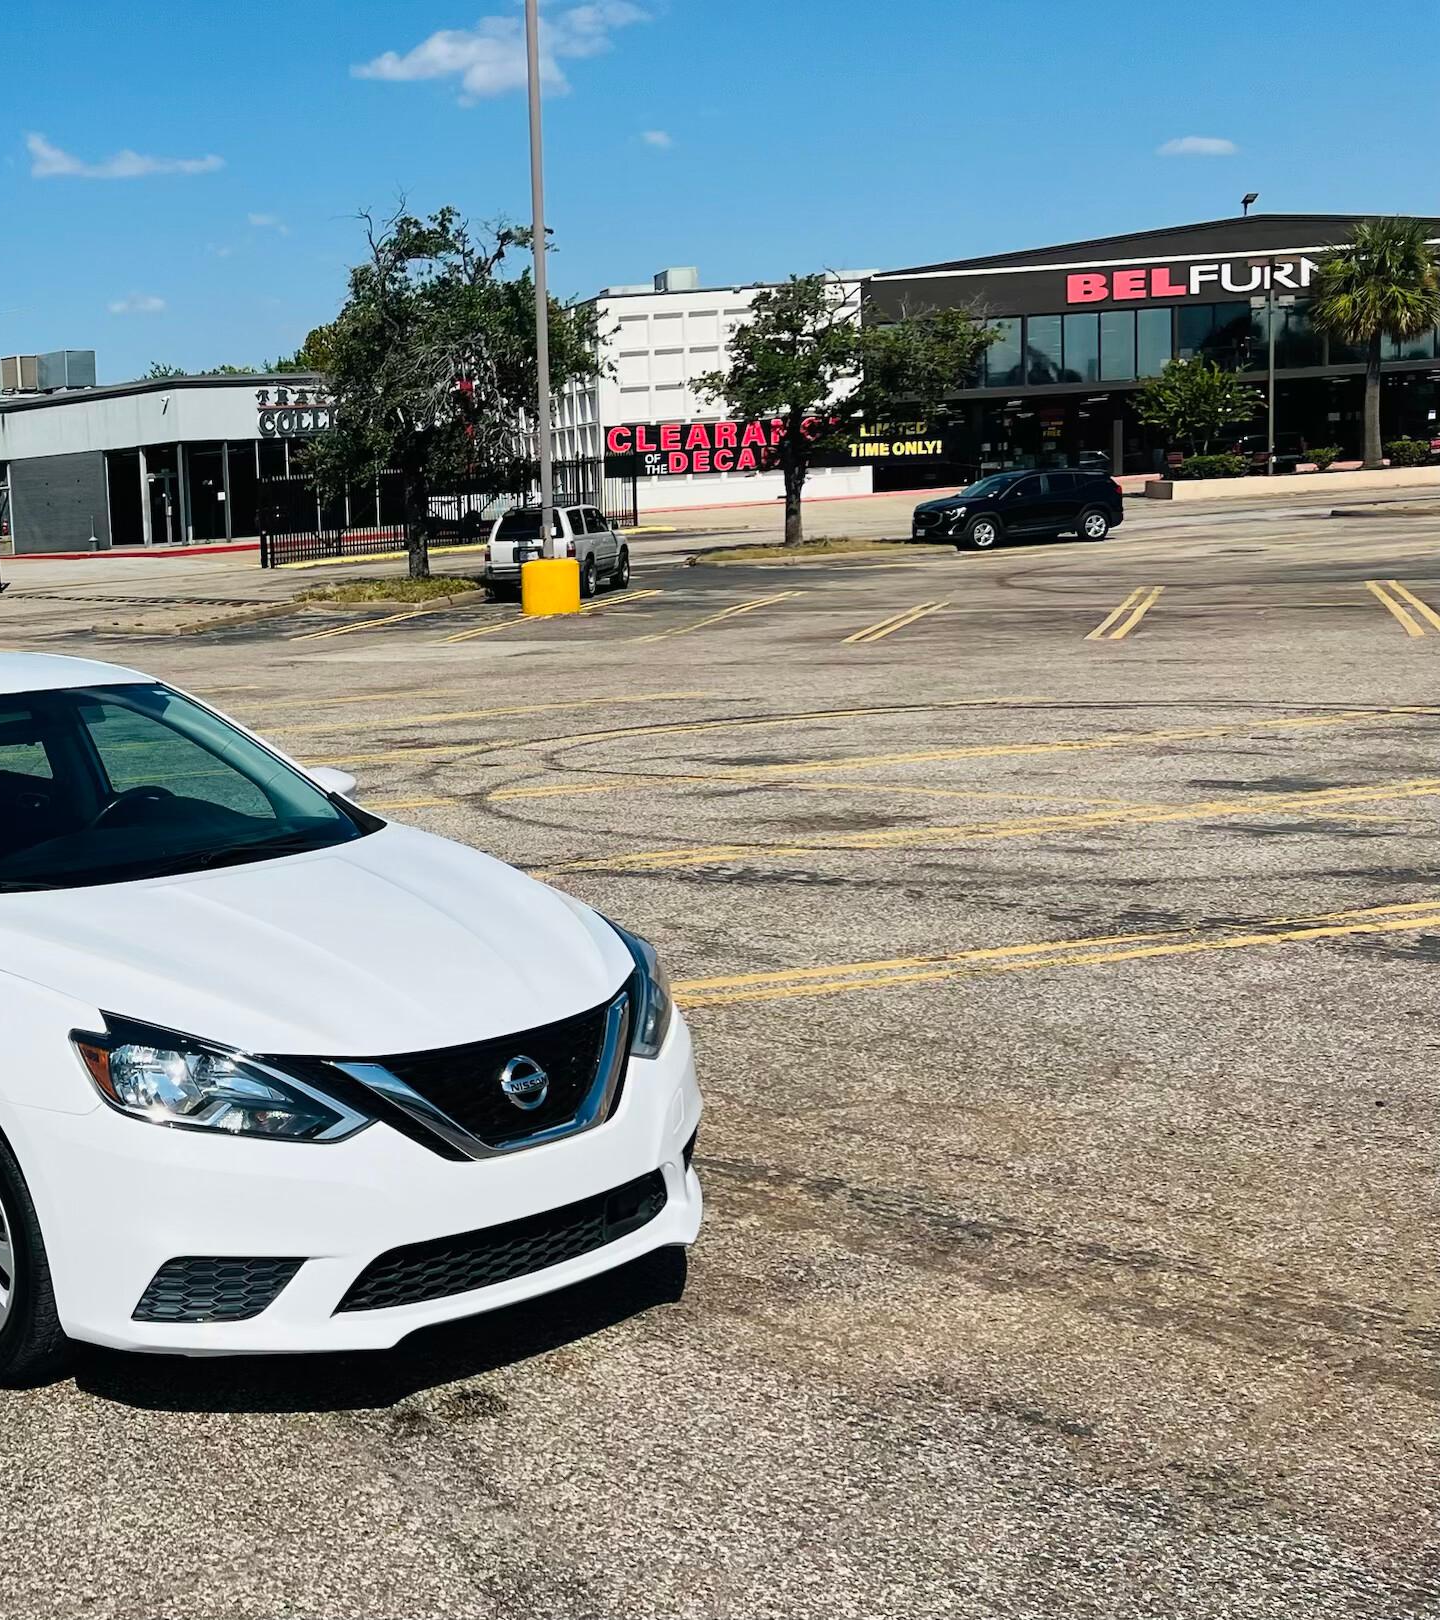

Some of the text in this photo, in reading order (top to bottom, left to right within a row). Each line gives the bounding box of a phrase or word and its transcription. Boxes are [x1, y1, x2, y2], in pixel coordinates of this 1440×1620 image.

[849, 440, 942, 457] TIME ONLY!
[644, 453, 661, 465] OF
[645, 464, 668, 475] THE
[510, 1076, 545, 1092] NISSAN
